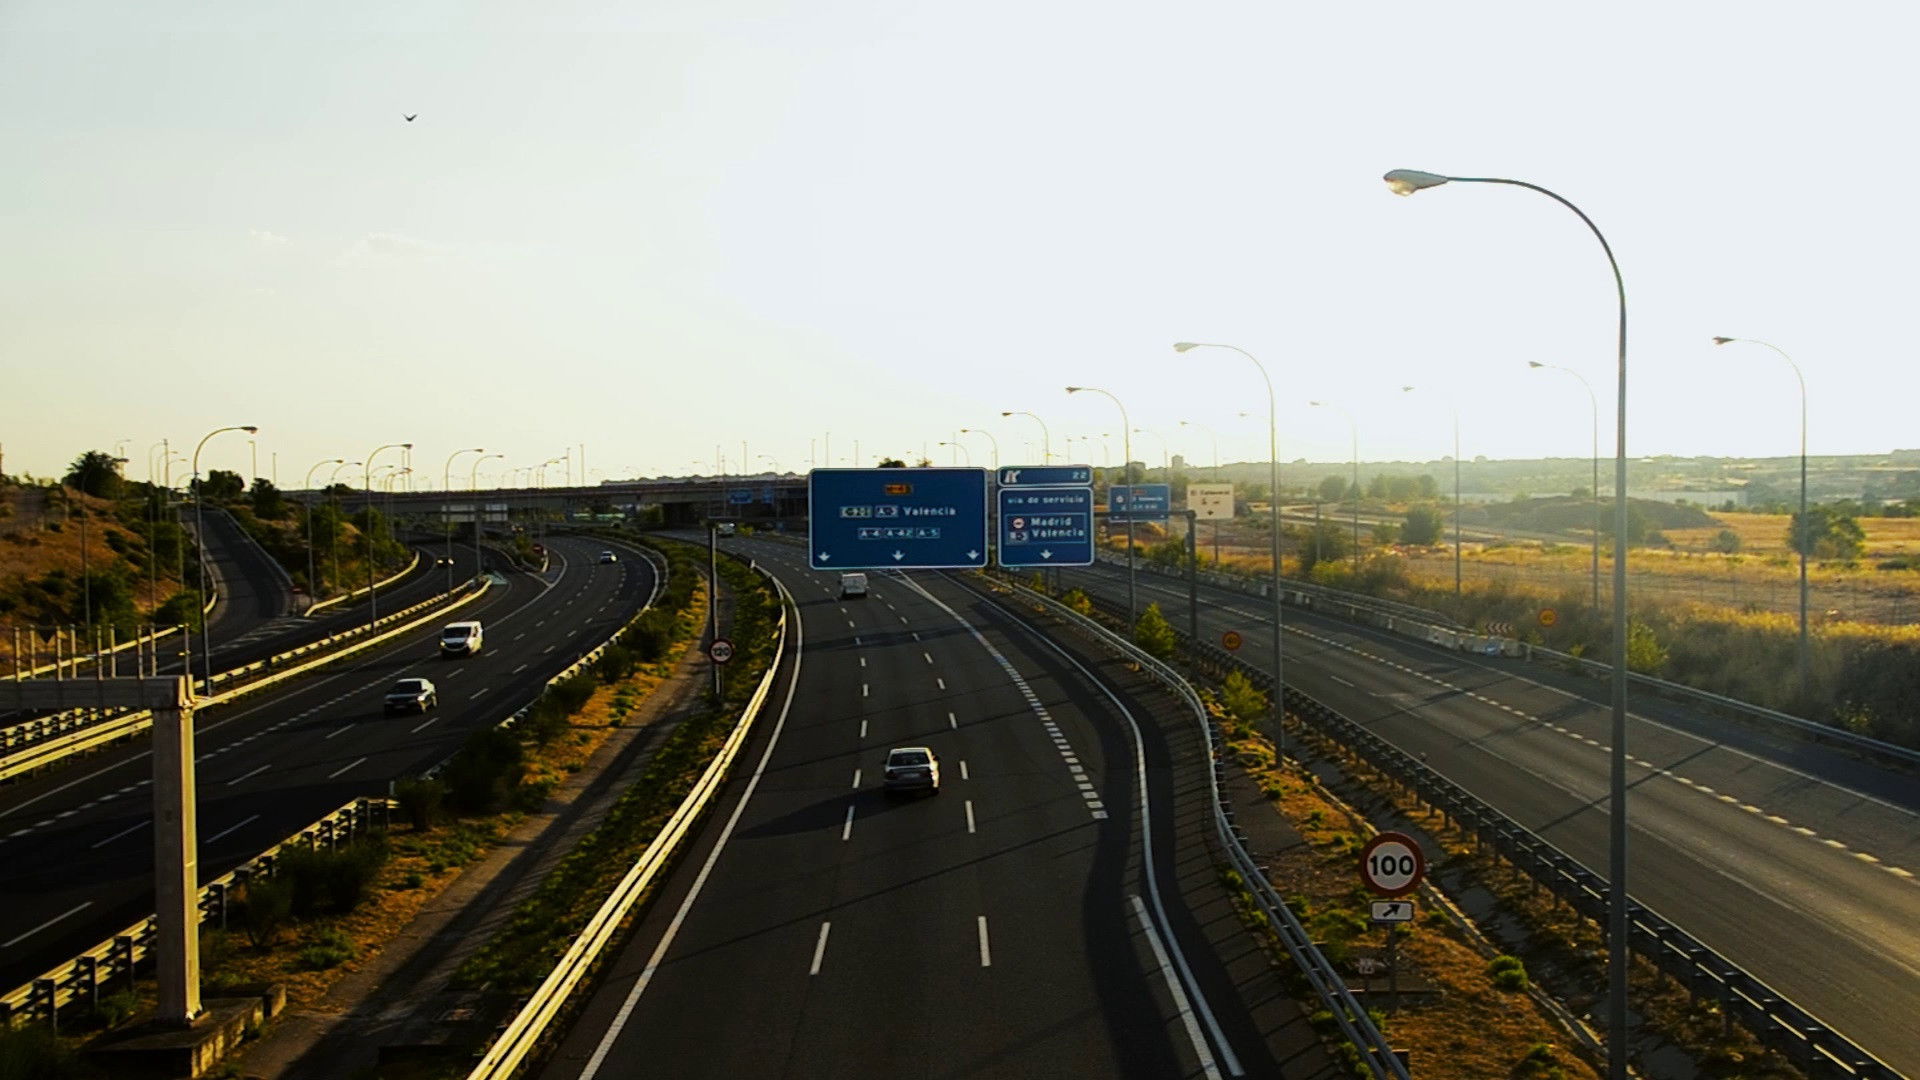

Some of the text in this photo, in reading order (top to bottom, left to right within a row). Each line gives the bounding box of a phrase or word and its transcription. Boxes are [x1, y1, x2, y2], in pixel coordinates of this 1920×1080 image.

[1072, 471, 1087, 479] 22
[1027, 496, 1039, 504] de
[1043, 496, 1084, 504] servicio
[902, 506, 957, 516] Valencia
[1030, 517, 1072, 526] Madrid
[1031, 529, 1084, 538] Valencia
[1369, 855, 1414, 876] 100
